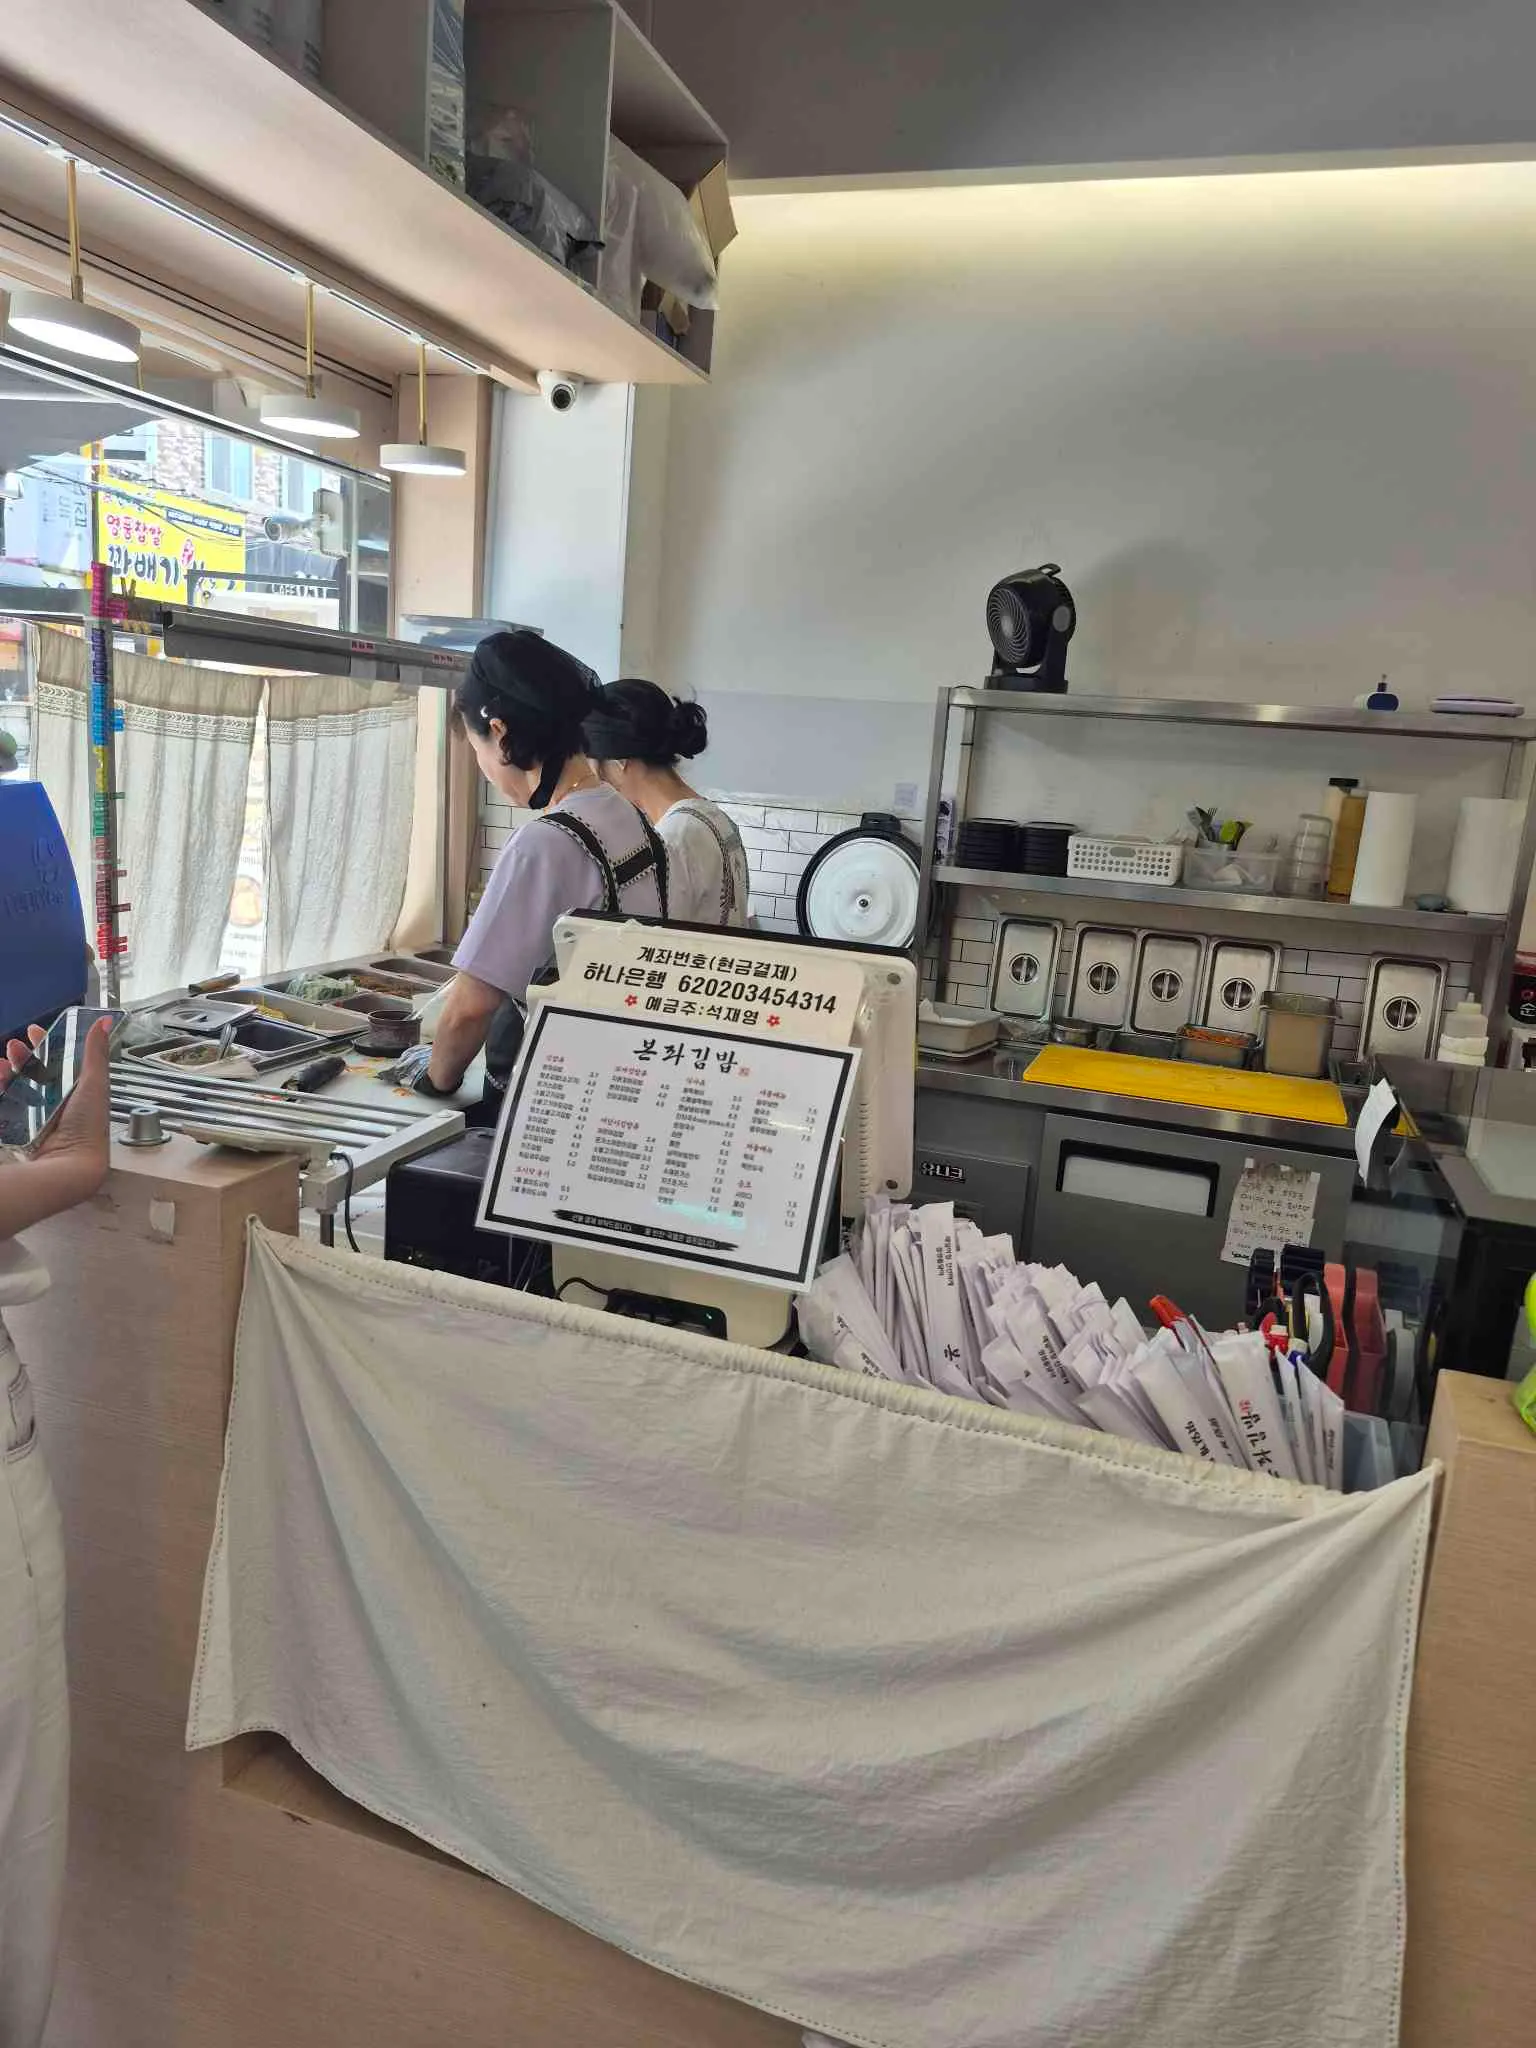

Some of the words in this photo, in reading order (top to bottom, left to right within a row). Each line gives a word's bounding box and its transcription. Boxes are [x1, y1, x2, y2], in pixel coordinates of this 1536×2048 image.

[636, 945, 798, 981] 계좌번호(현금결제)
[583, 962, 667, 990] 하나은행
[678, 974, 837, 1014] 620203454314
[645, 995, 759, 1026] 예금주:석재영
[633, 1038, 738, 1074] 본좌김밥
[1240, 1411, 1280, 1479] 좌김밥
